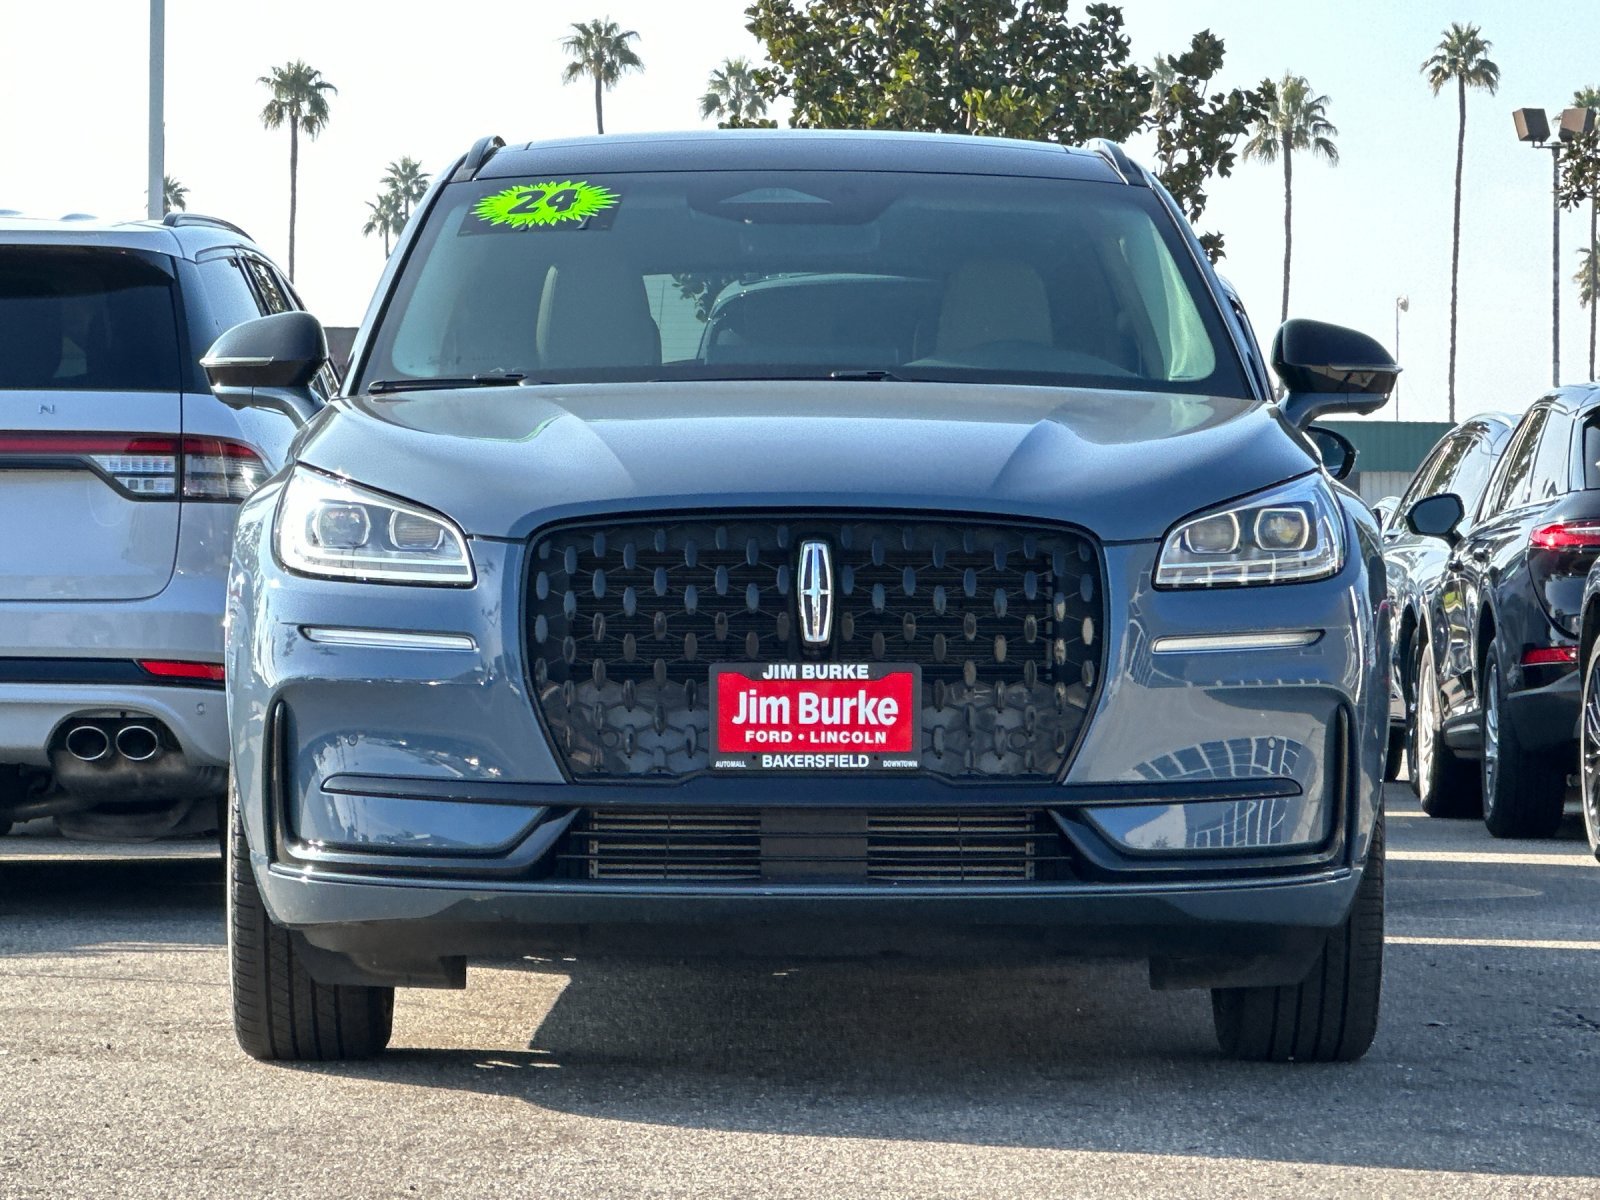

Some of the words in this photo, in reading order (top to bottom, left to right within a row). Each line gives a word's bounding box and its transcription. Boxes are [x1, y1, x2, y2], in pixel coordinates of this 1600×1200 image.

[508, 189, 579, 214] 24
[762, 664, 797, 680] JIM
[801, 664, 869, 680] BURKE
[732, 690, 790, 724] Jim
[798, 690, 899, 726] Burke
[745, 730, 793, 743] FORD
[809, 730, 887, 743] LINCOLN
[715, 760, 746, 768] AUTOMALL
[762, 754, 869, 768] BAKERSFIELD
[883, 760, 918, 768] DOWNTOWN
